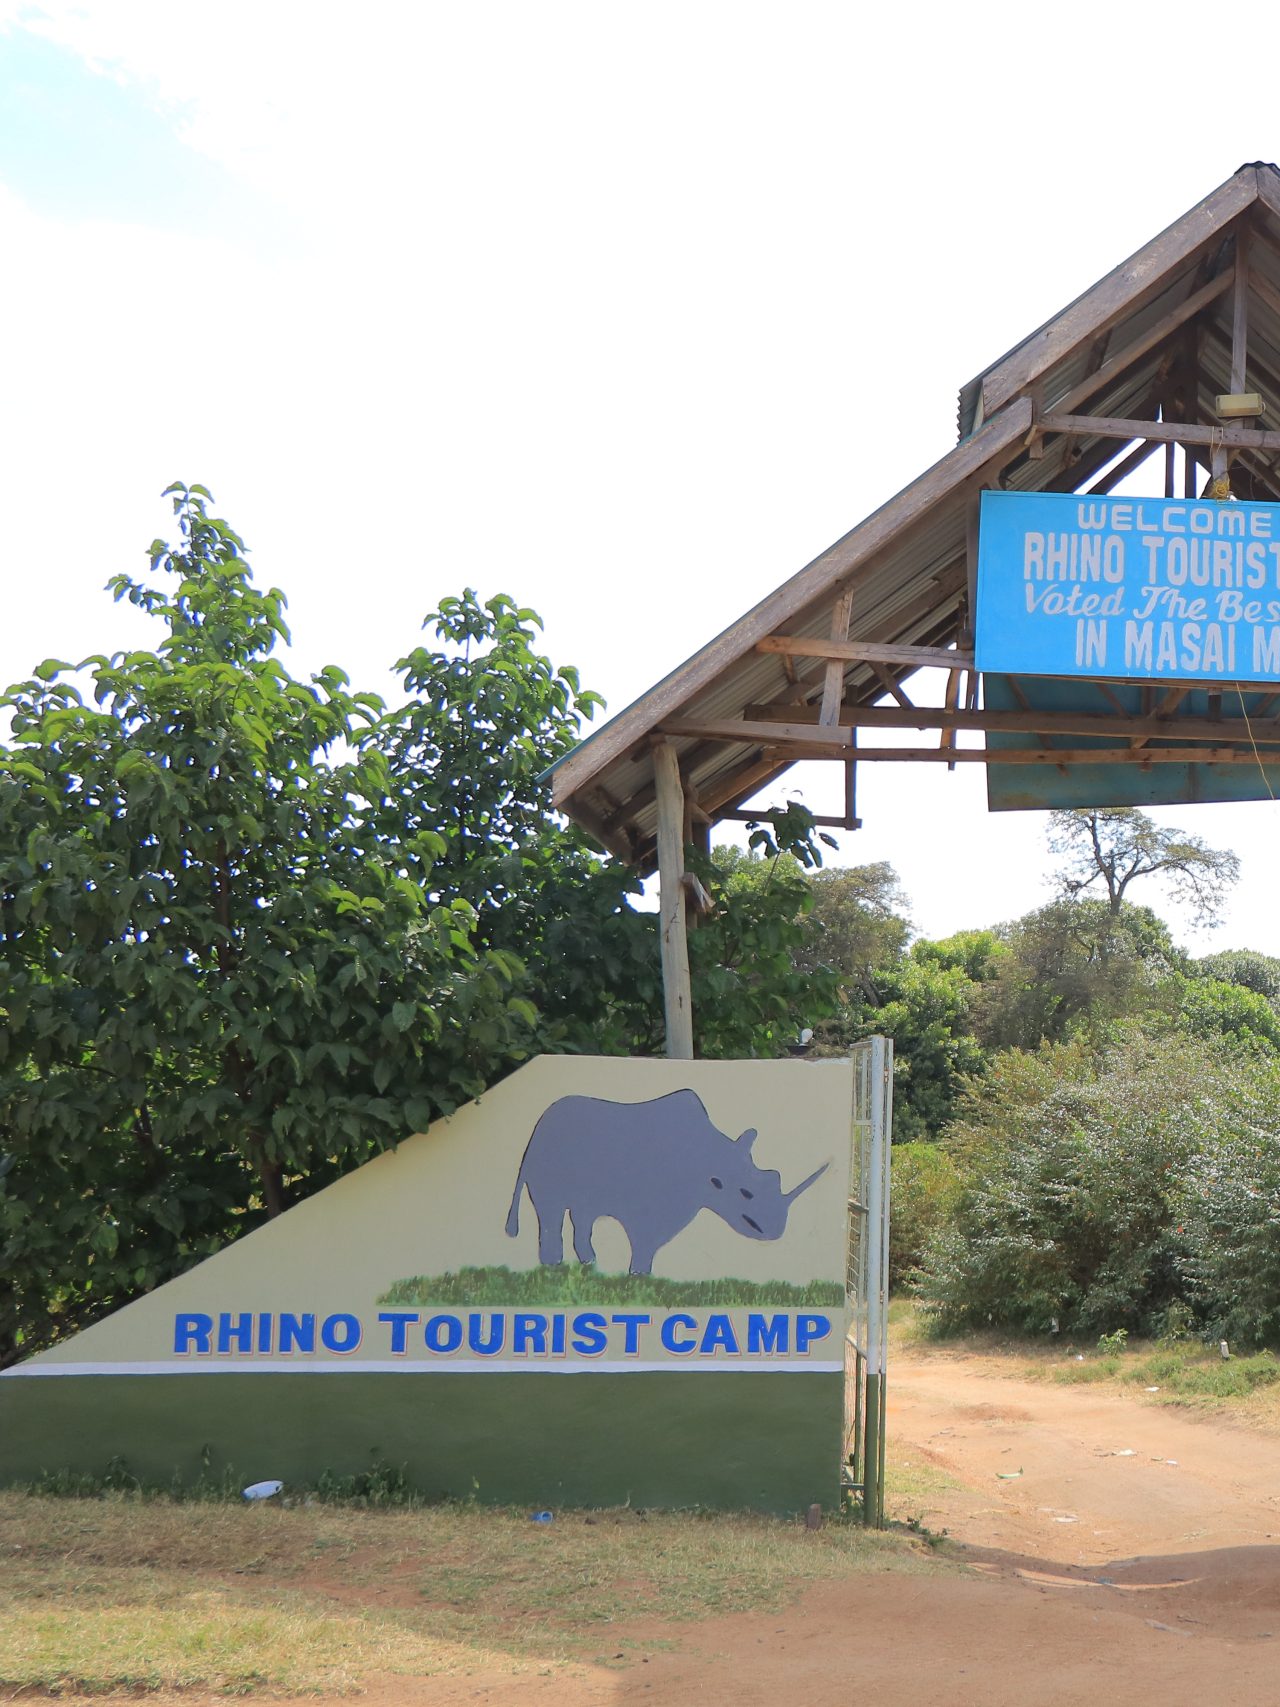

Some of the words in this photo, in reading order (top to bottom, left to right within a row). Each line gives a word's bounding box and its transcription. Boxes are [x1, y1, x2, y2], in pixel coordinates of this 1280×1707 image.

[1078, 503, 1271, 537] WELCOME
[1024, 532, 1125, 582] RHINO
[1024, 583, 1125, 616] Voted
[1133, 587, 1207, 622] The
[1075, 619, 1107, 668] IN
[1124, 621, 1236, 673] MASAI
[174, 1313, 364, 1355] RHINO
[379, 1313, 651, 1355] TOURIST
[660, 1313, 833, 1355] CAMP
